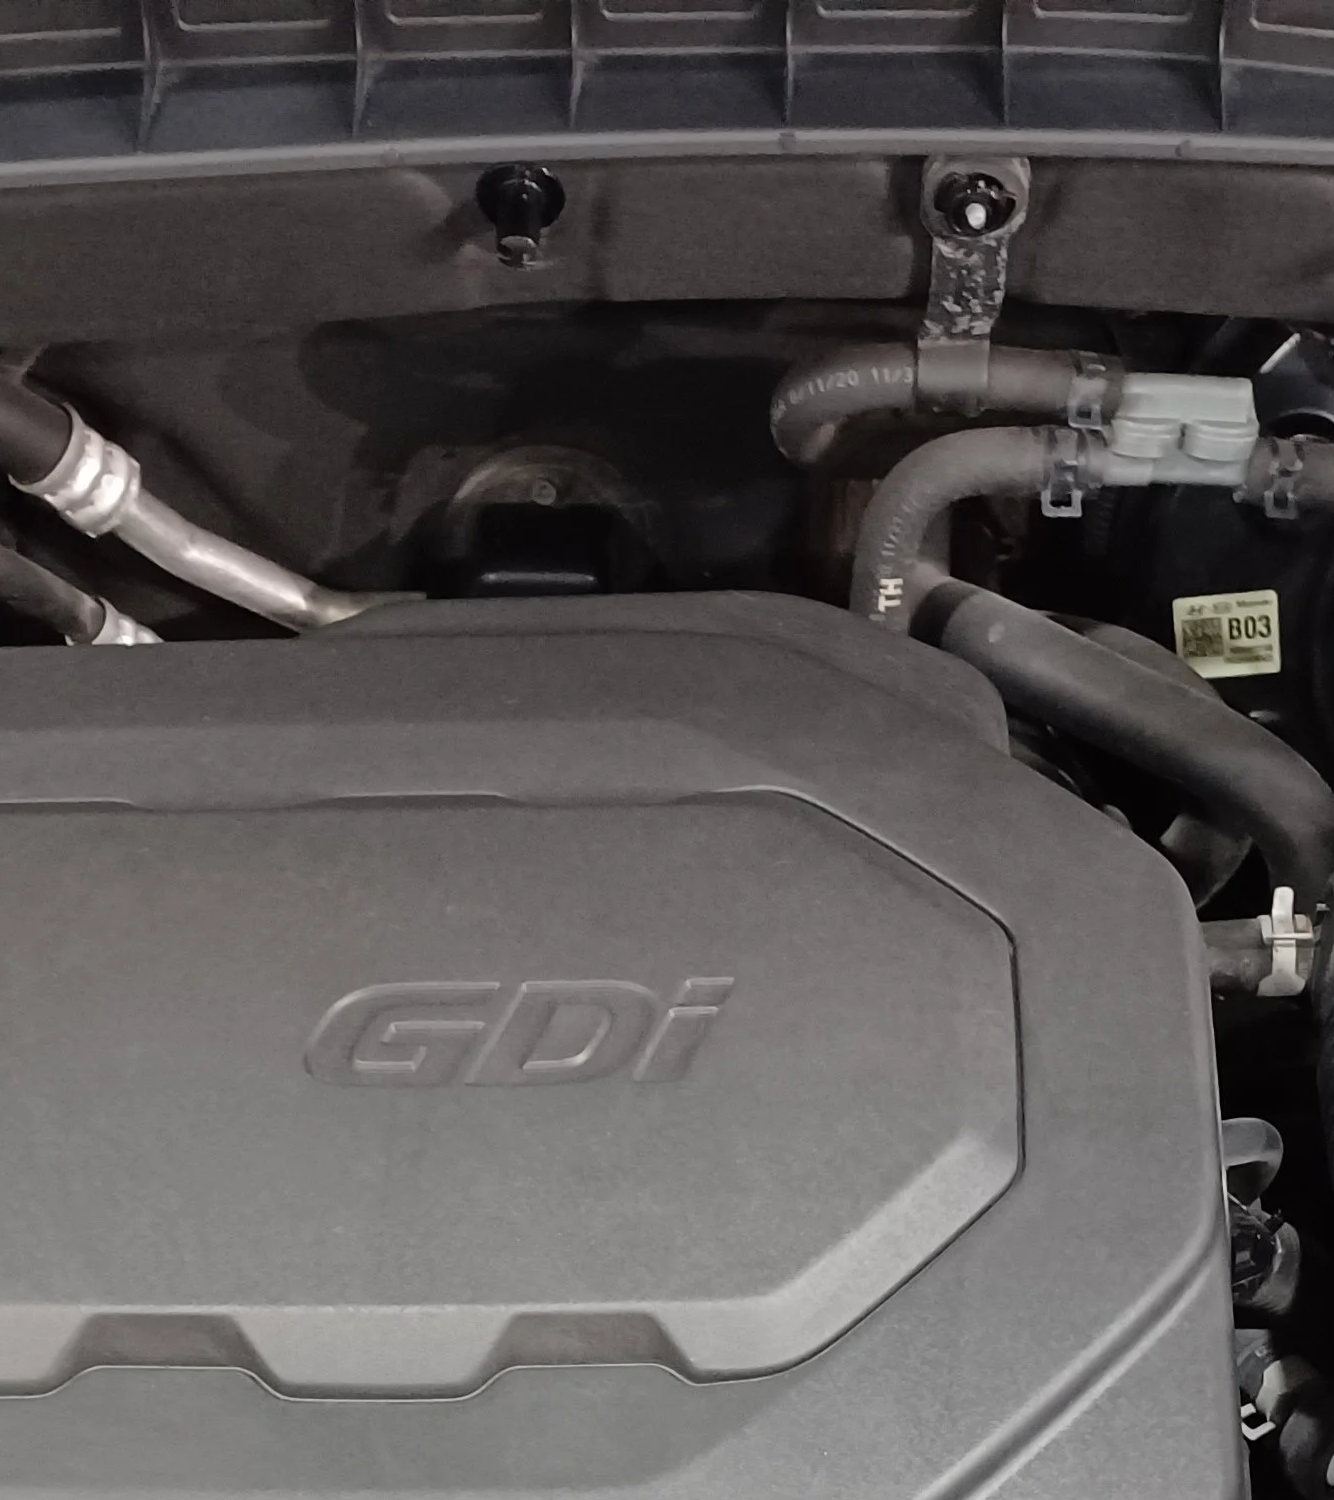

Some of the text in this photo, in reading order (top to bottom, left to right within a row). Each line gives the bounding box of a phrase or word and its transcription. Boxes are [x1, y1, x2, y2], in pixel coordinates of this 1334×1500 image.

[876, 577, 904, 613] TH
[1228, 614, 1272, 640] B03
[303, 977, 735, 1087] GDi
